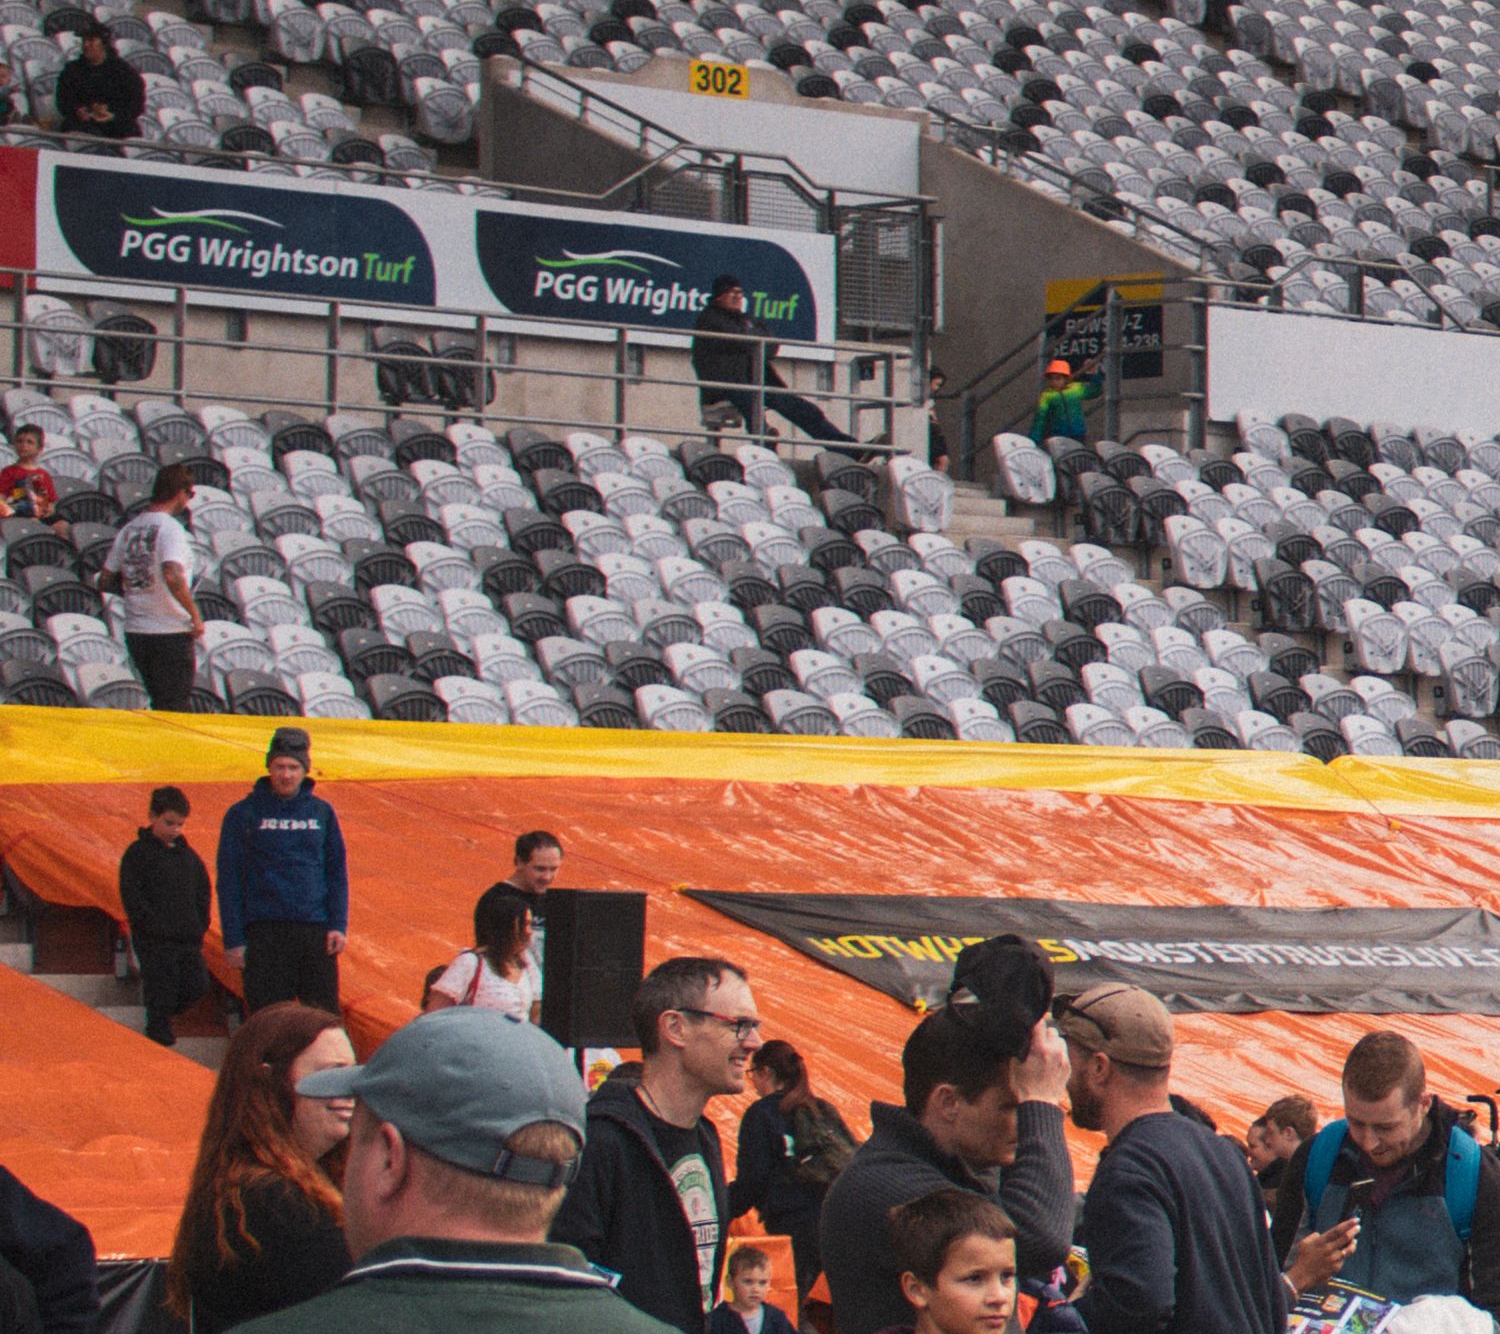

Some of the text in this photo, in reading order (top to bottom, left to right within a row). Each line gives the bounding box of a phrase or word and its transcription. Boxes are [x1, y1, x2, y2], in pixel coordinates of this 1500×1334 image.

[696, 64, 743, 96] 302
[120, 229, 417, 284] PGG Wrightson Turf
[534, 270, 799, 320] PGG Wrights Turf
[1053, 337, 1099, 357] EATS
